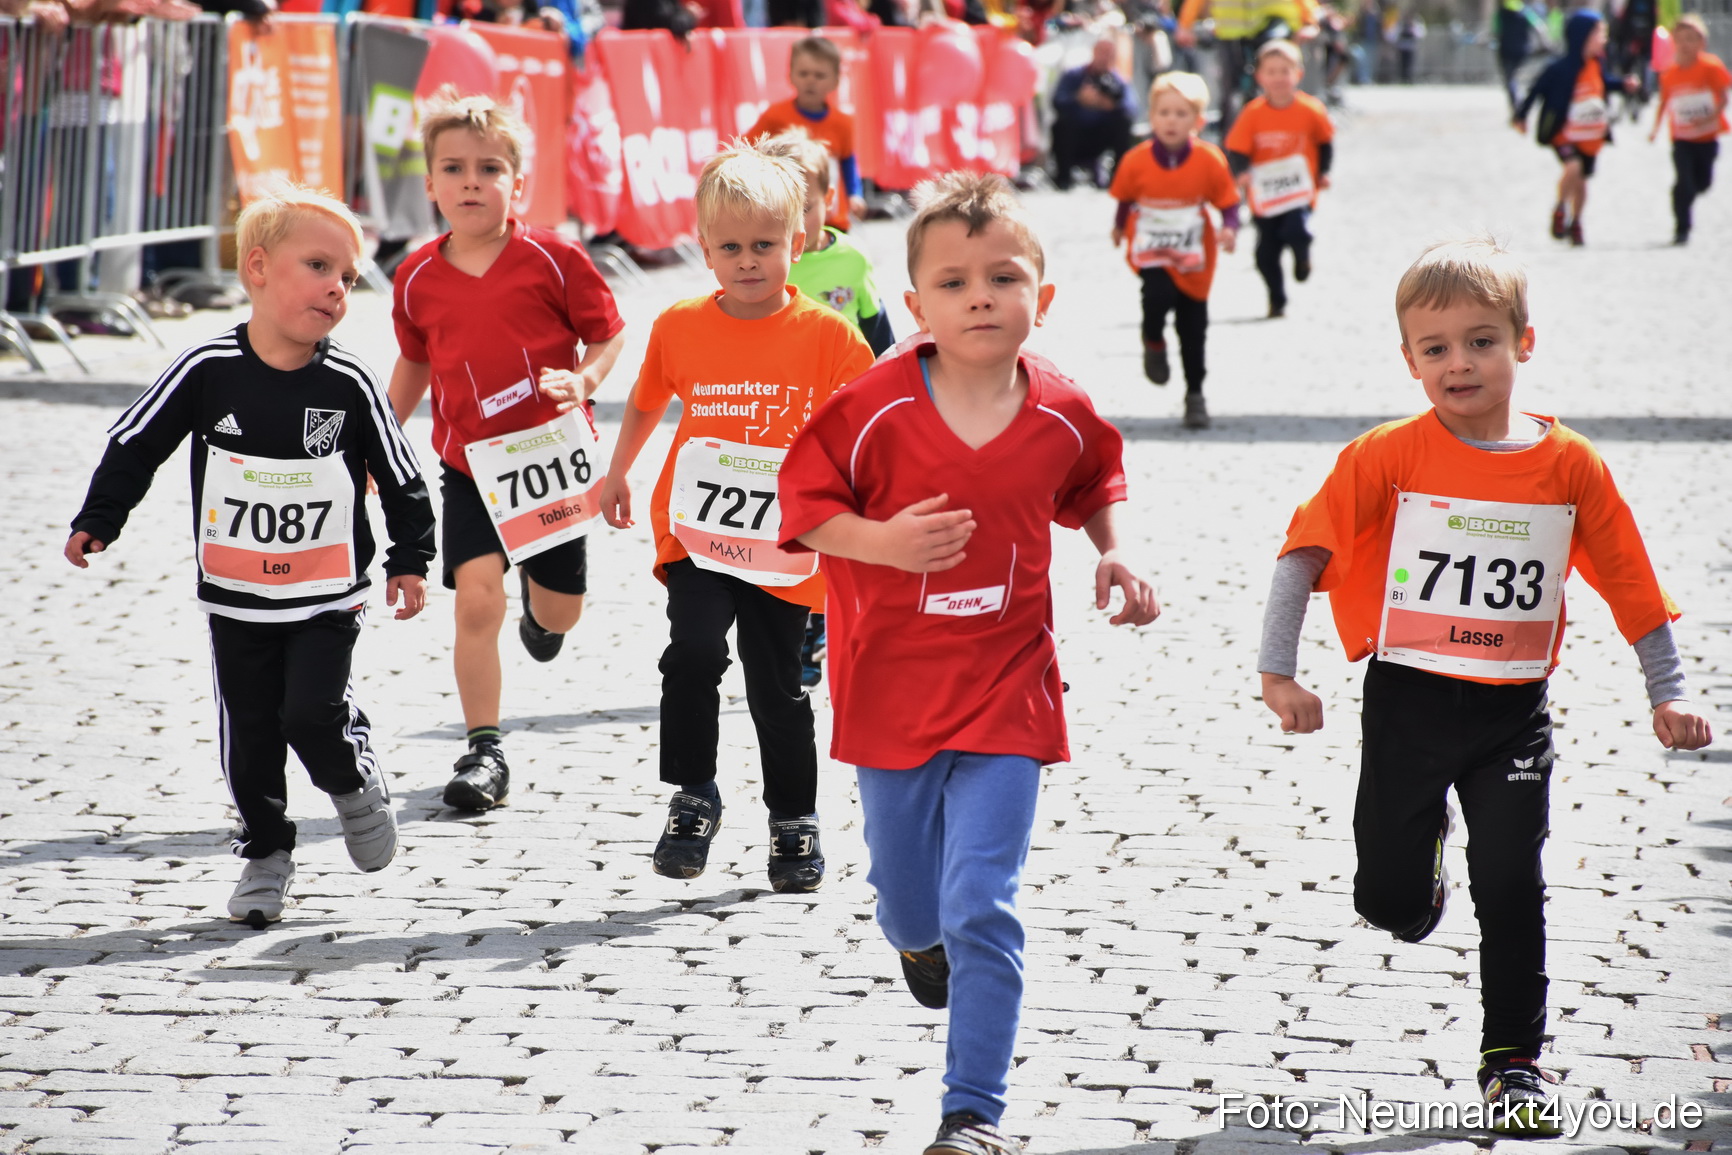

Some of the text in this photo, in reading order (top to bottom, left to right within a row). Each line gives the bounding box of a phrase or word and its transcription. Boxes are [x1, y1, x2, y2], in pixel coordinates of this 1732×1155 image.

[692, 381, 780, 396] Neumarkter
[496, 390, 519, 407] DEHN
[691, 401, 760, 420] Stadtlauf
[214, 424, 242, 436] adidas
[519, 429, 566, 451] BOCK
[259, 472, 312, 485] BOCK
[496, 448, 592, 509] 7018
[538, 503, 582, 526] Tobias
[696, 480, 782, 531] 727
[224, 496, 333, 544] 7087
[1467, 517, 1531, 536] BOCK
[206, 528, 217, 538] B2
[710, 540, 752, 563] MAXI
[263, 559, 291, 575] Leo
[1418, 549, 1545, 611] 7133
[947, 596, 982, 610] DEHN
[1392, 590, 1404, 601] B1
[1449, 625, 1504, 648] Lasse
[1507, 770, 1542, 782] erima
